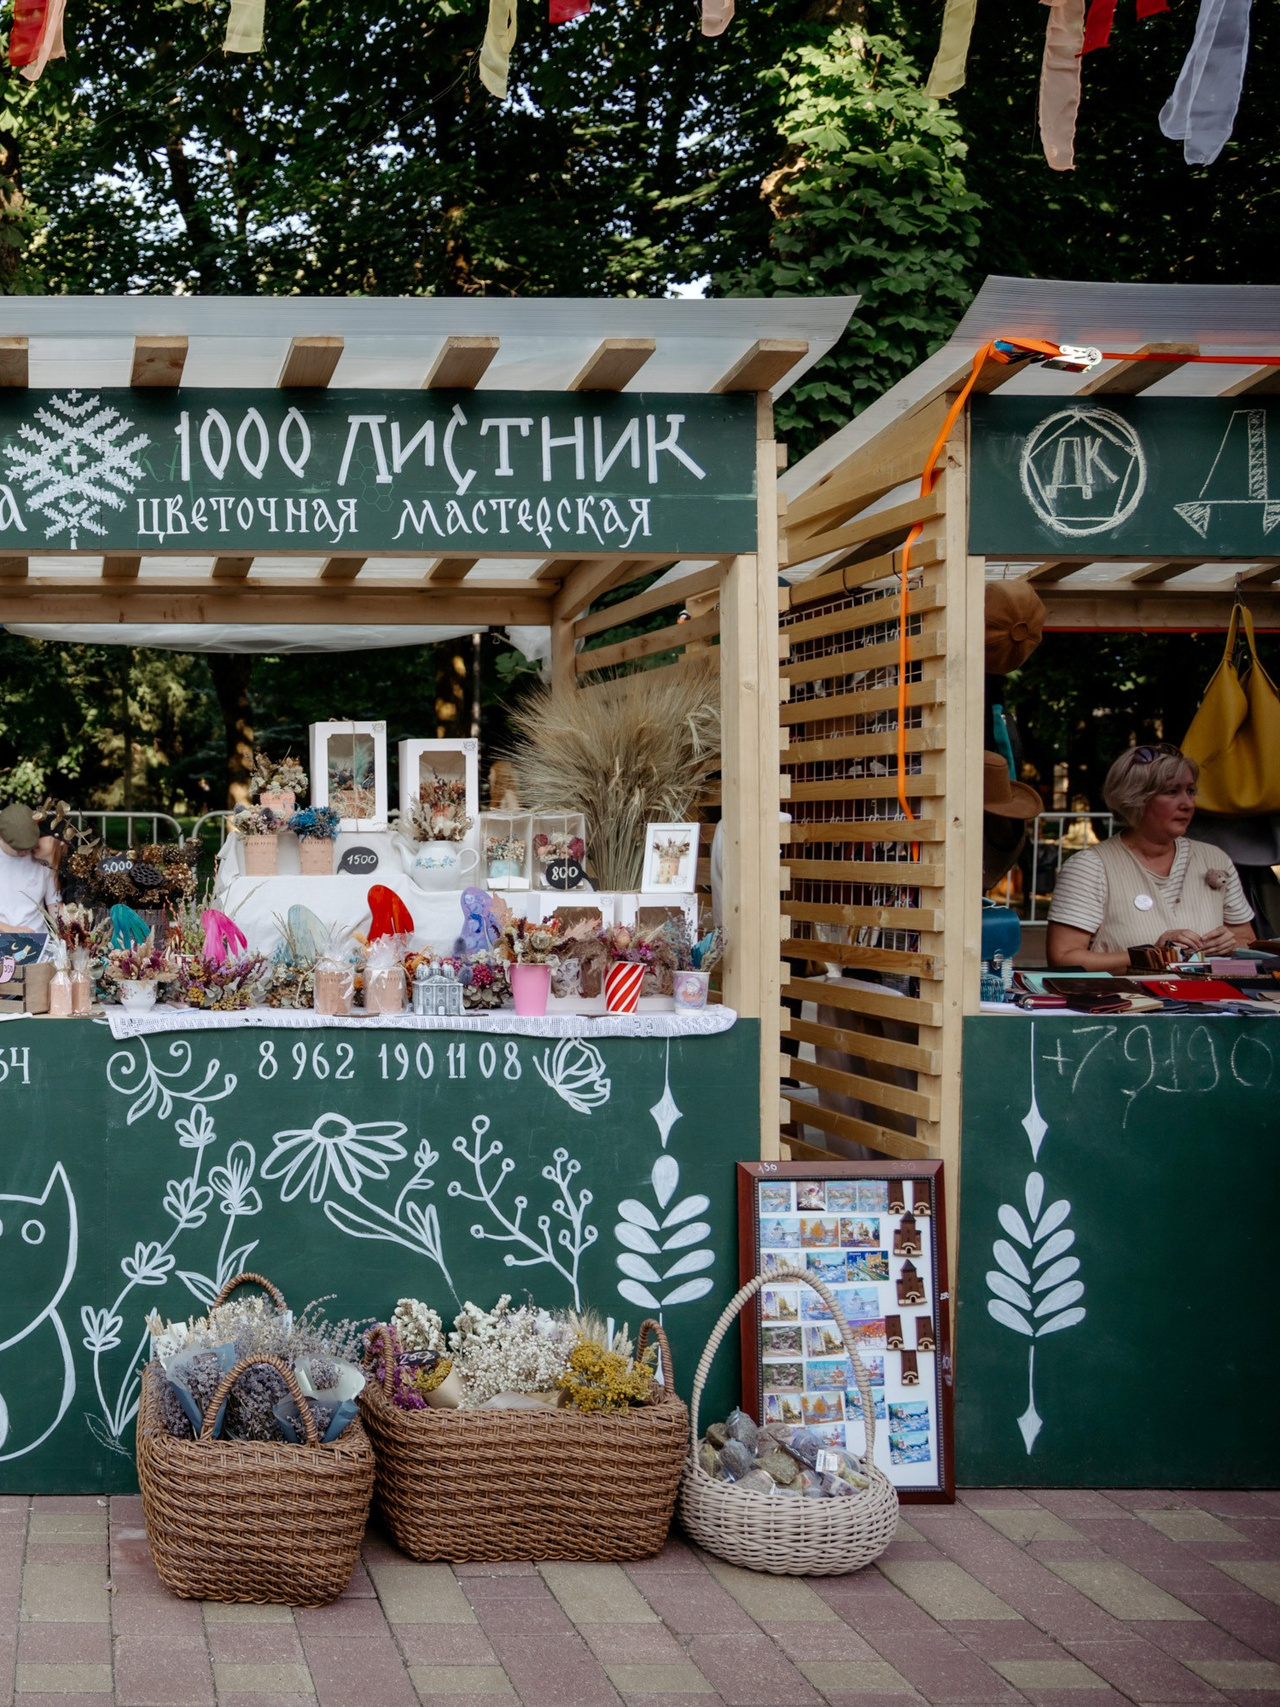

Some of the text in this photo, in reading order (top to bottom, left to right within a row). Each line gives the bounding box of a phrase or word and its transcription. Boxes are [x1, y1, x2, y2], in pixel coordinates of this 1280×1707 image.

[174, 407, 312, 482] 1000
[338, 404, 706, 496] ЛИСТНИК
[1045, 436, 1120, 499] ДК
[347, 853, 377, 865] 1500
[102, 860, 133, 874] 3000
[551, 866, 579, 881] 800
[4, 964, 14, 974] 350
[258, 1040, 278, 1080] 8
[291, 1041, 356, 1081] 962
[757, 1162, 778, 1174] 150
